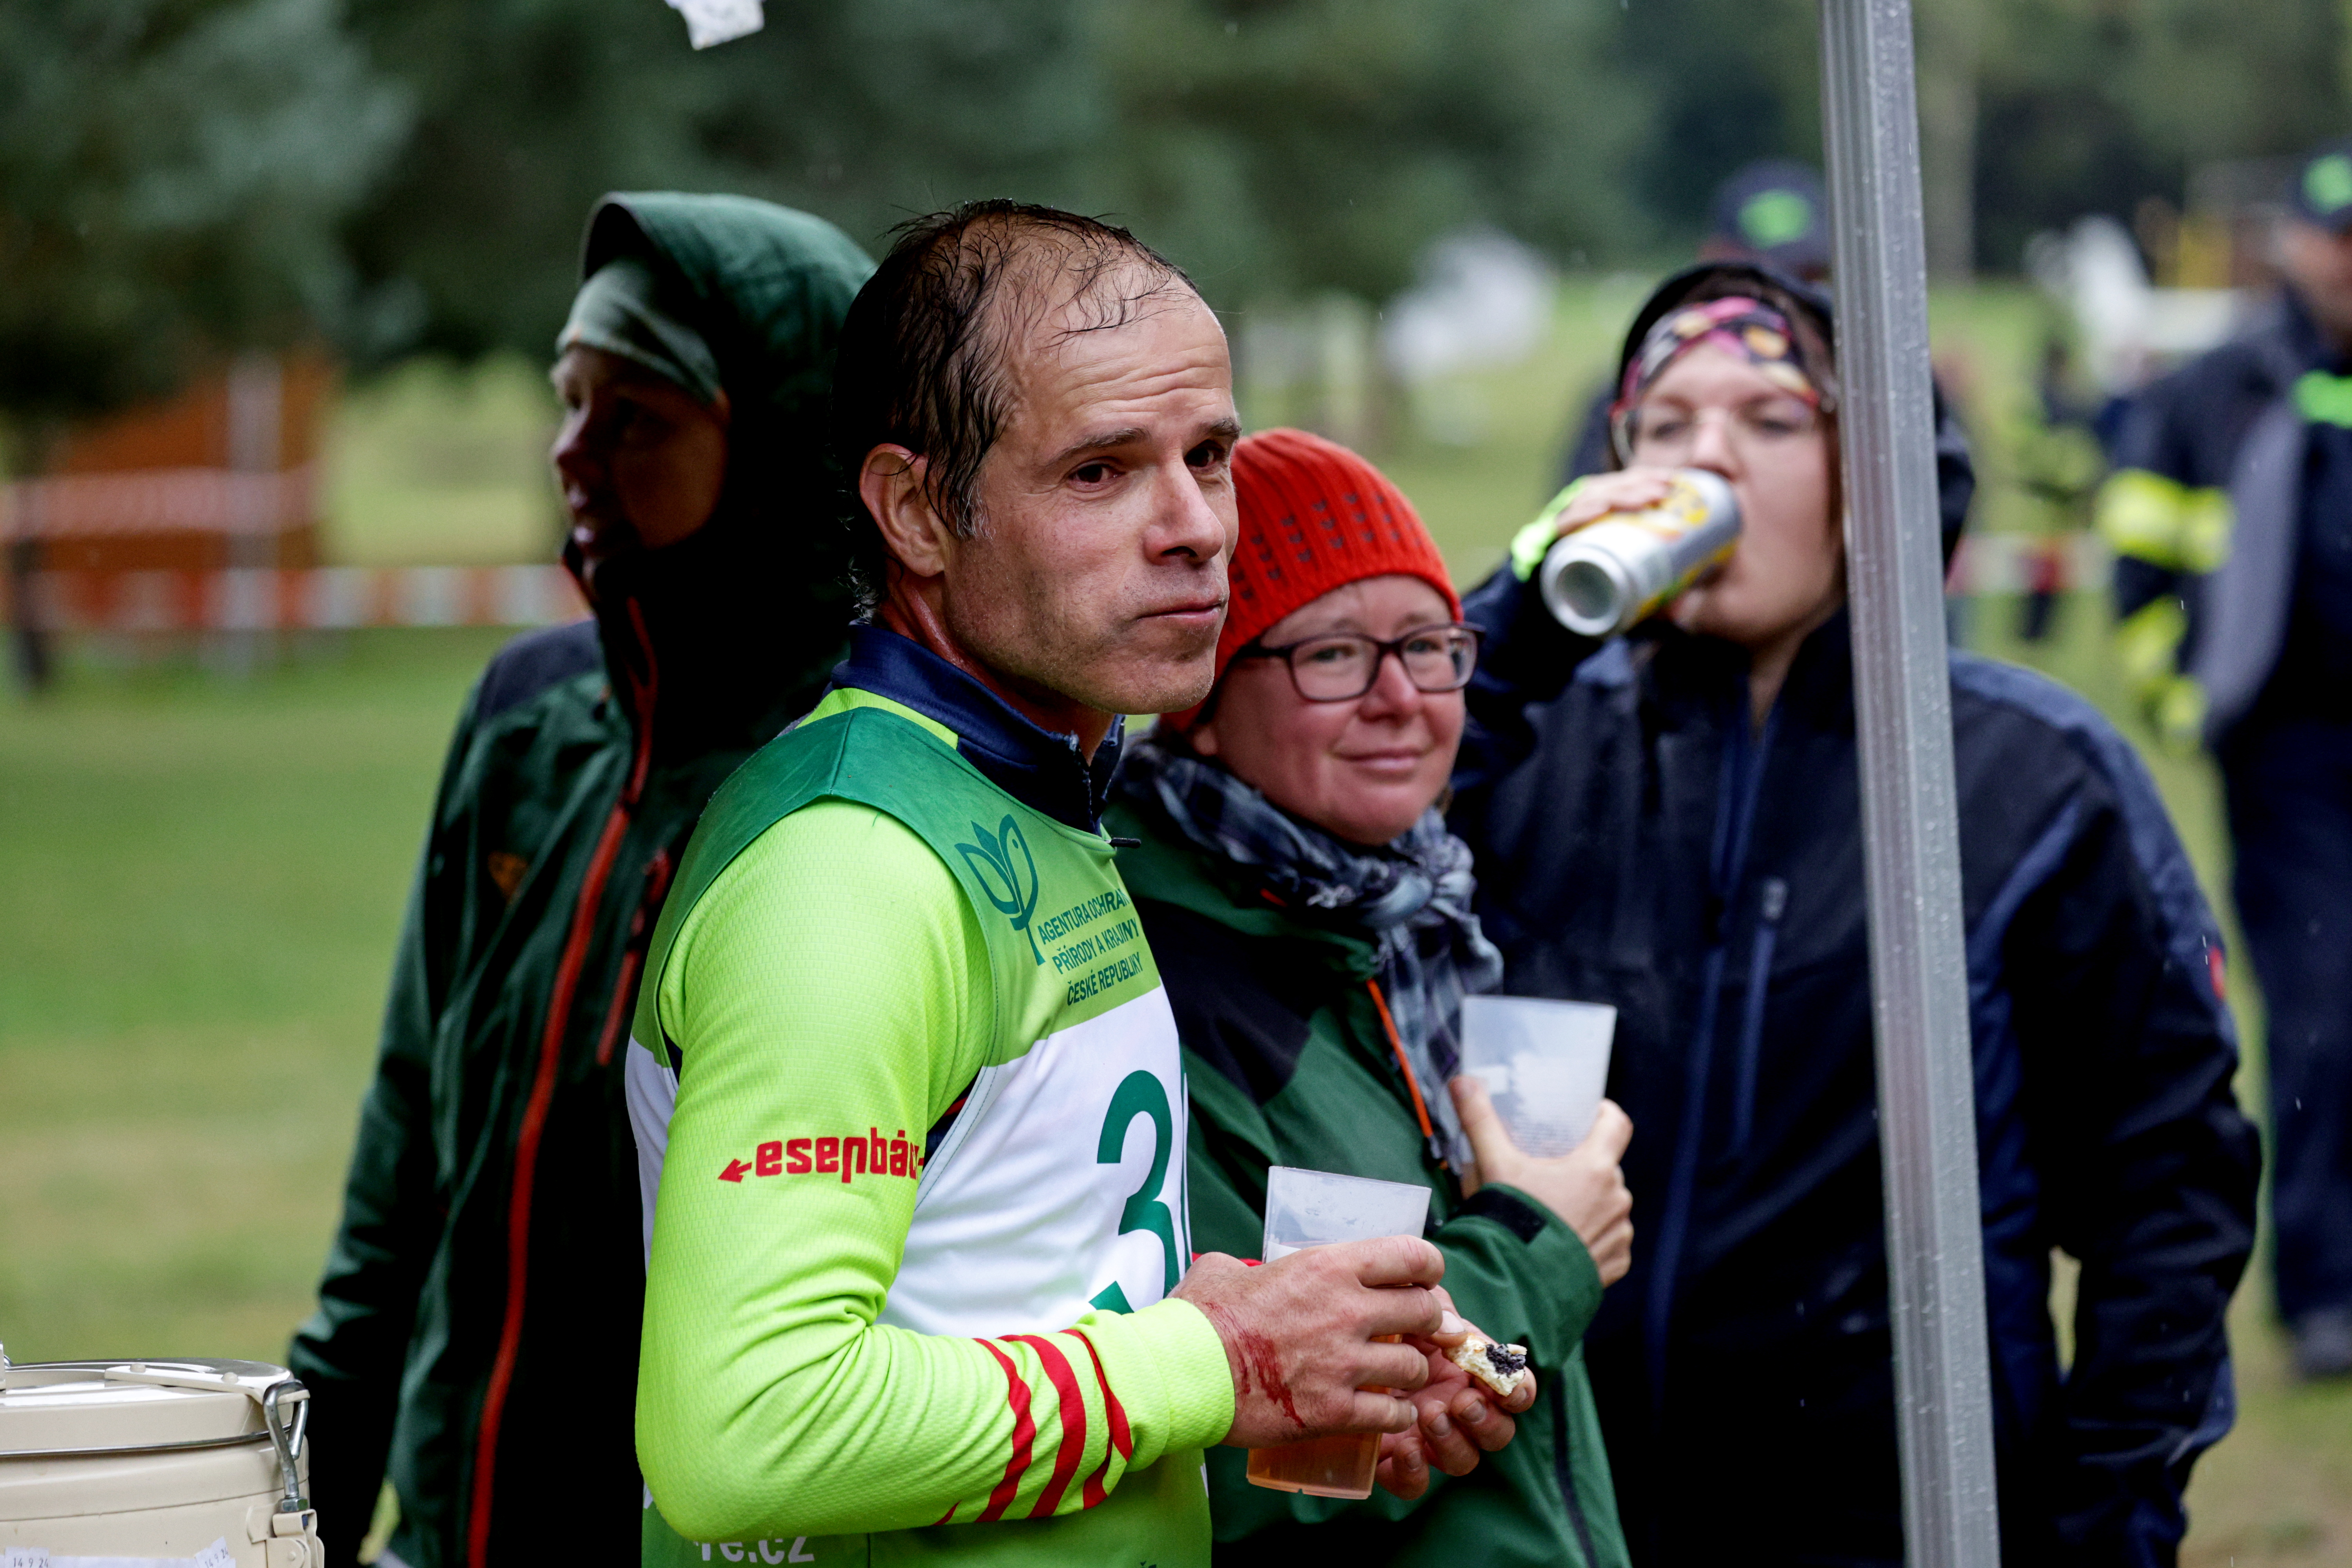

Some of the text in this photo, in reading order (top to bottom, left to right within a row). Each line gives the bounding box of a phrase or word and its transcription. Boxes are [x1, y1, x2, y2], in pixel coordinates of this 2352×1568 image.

[1037, 888, 1130, 945] AGENTURA OCHRAN
[1052, 917, 1139, 975] PŘÍRODY A KRAJINY
[1067, 951, 1143, 1006] ČESKÉ REPUBLIKY
